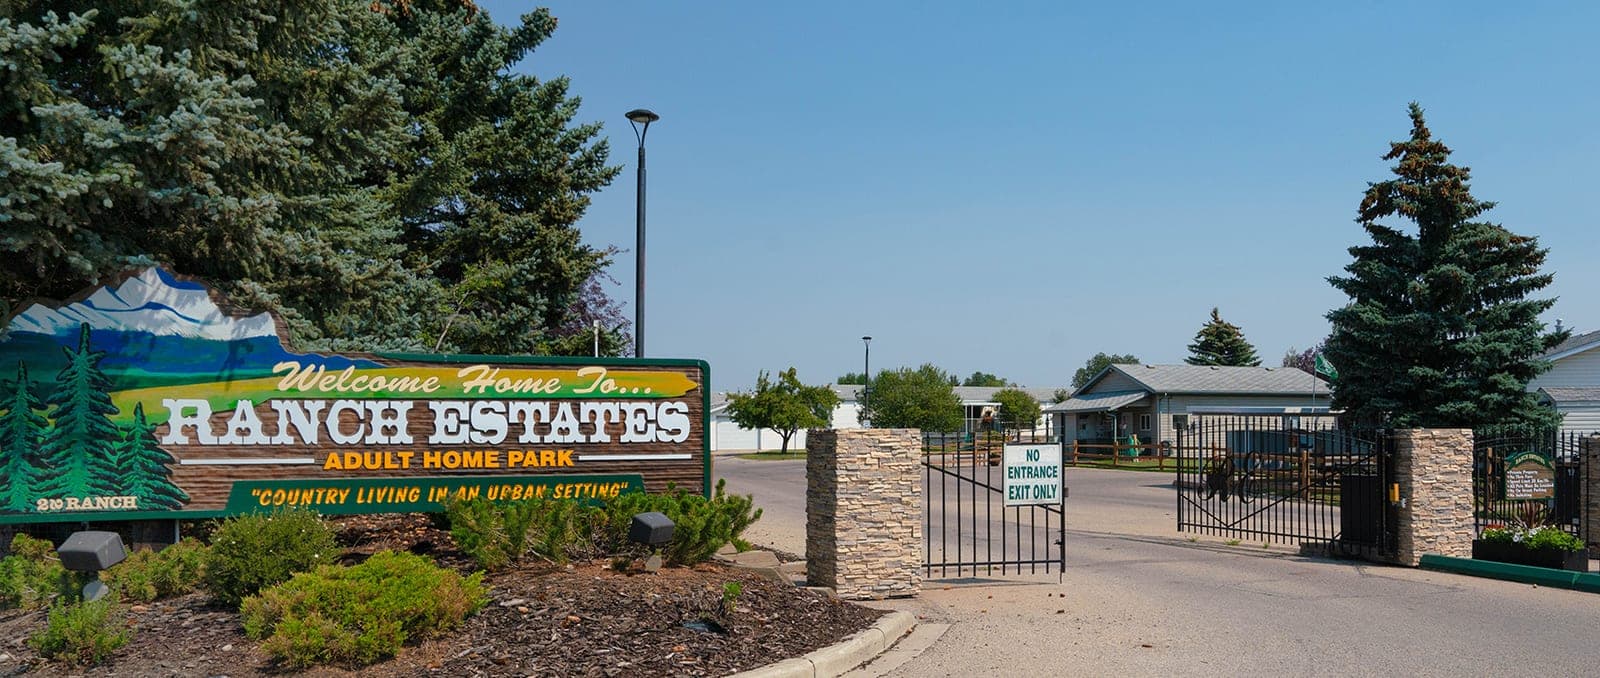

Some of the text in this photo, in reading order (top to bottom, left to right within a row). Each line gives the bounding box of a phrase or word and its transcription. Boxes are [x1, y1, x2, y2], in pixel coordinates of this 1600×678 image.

[272, 361, 651, 394] Welcome Home To...
[162, 399, 690, 446] RANCH ESTATES
[324, 448, 575, 470] ADULT HOME PARK
[1026, 449, 1040, 461] NO
[1008, 466, 1058, 479] ENTRANCE
[251, 487, 350, 506] "COUNTRY
[356, 487, 421, 504] LIVING
[427, 485, 449, 503] IN
[456, 485, 481, 501] AN
[1009, 484, 1057, 500] EXIT ONLY
[65, 496, 138, 510] RANCH
